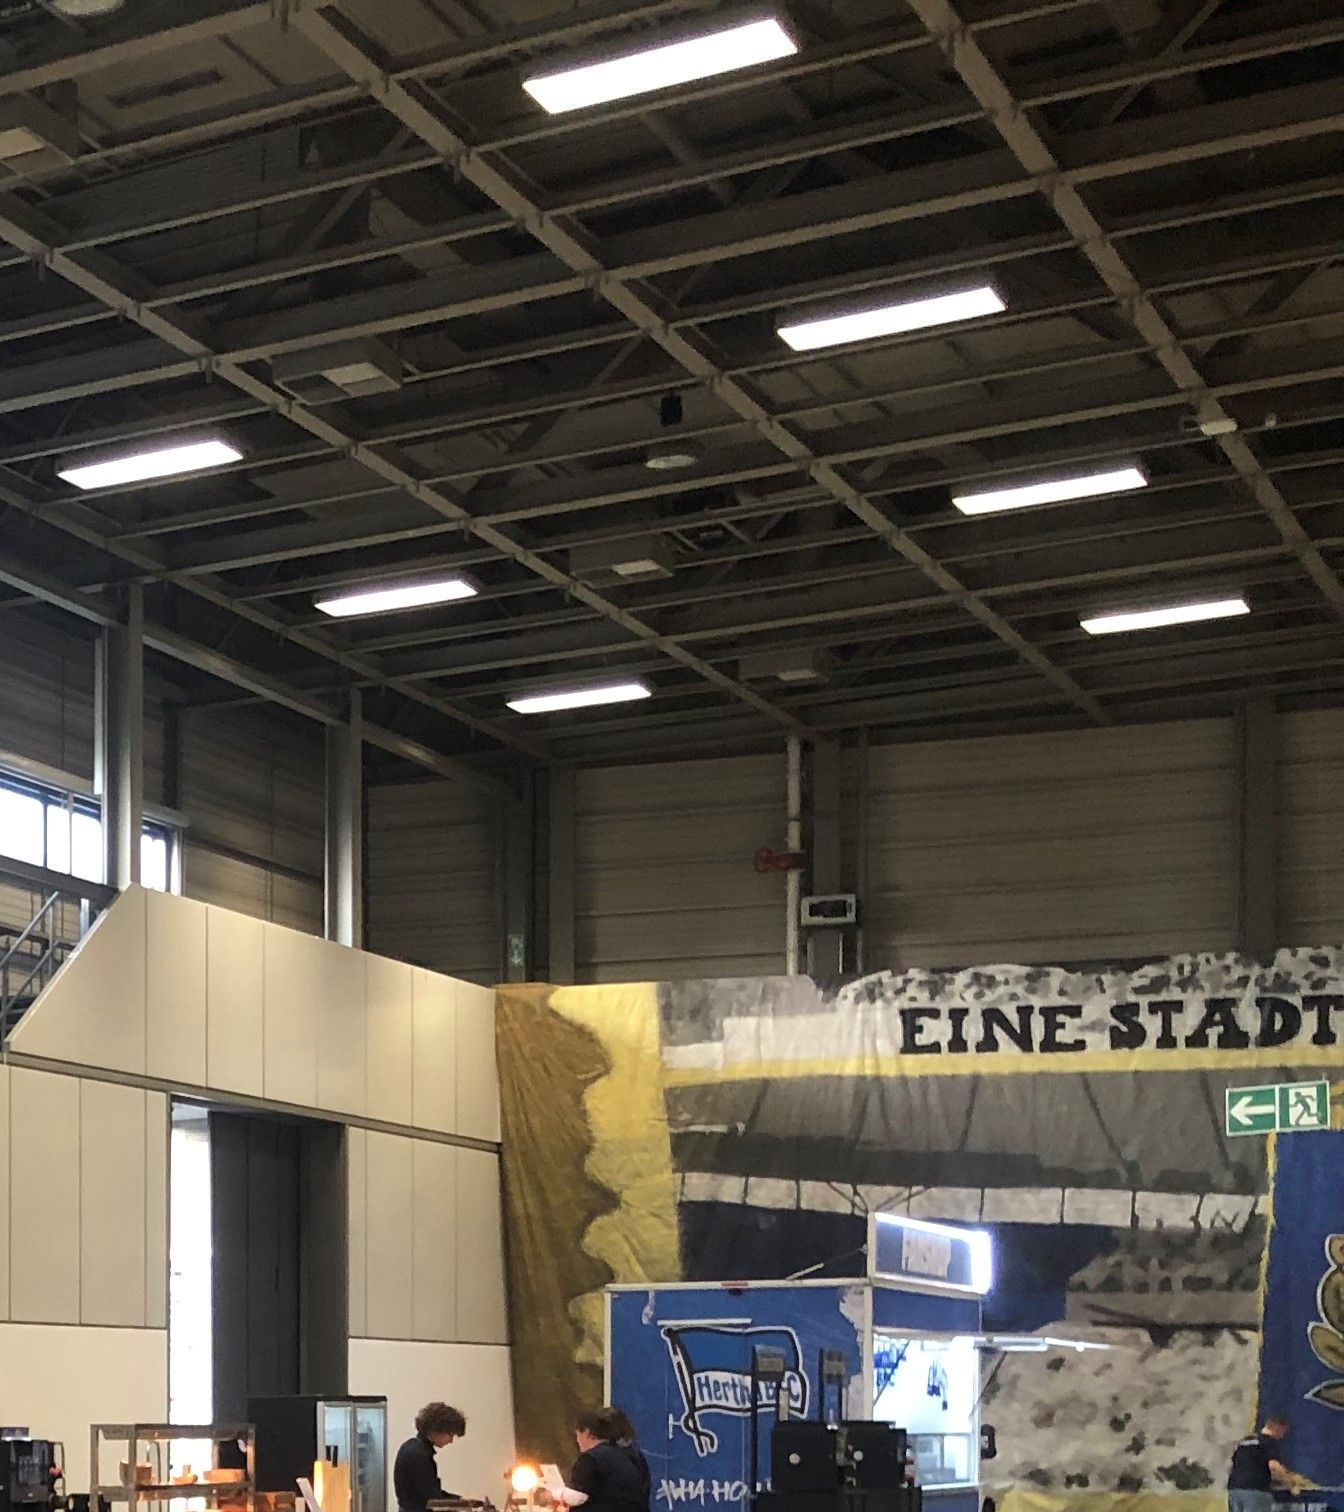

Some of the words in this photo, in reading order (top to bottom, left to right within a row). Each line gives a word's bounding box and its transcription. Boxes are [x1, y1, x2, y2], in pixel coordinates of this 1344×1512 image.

[899, 1004, 1087, 1055] EINE
[1109, 993, 1344, 1050] STADT
[695, 1374, 762, 1406] Herth
[764, 1374, 801, 1403] BC
